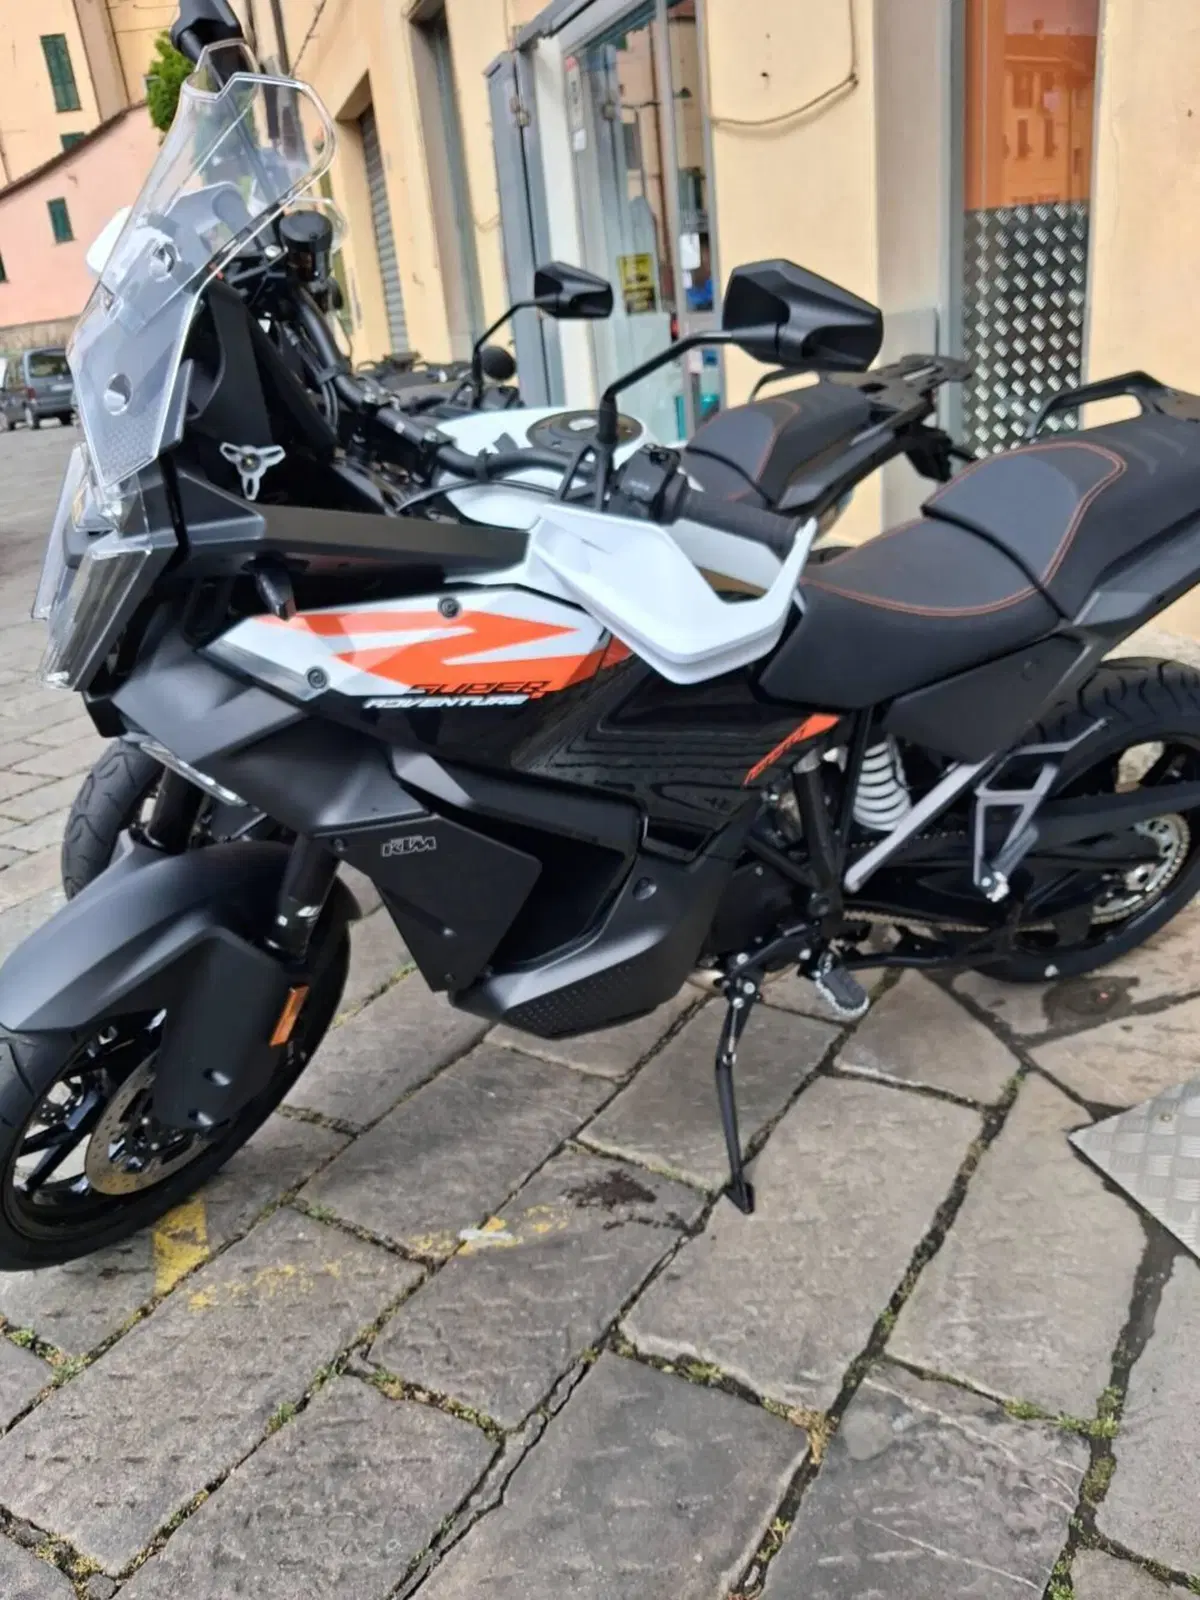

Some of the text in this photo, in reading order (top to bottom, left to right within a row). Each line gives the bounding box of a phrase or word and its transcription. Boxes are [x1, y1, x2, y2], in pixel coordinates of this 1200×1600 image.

[404, 681, 550, 698] SUPER
[362, 694, 530, 709] ADVENTURE
[382, 835, 437, 857] KTM
